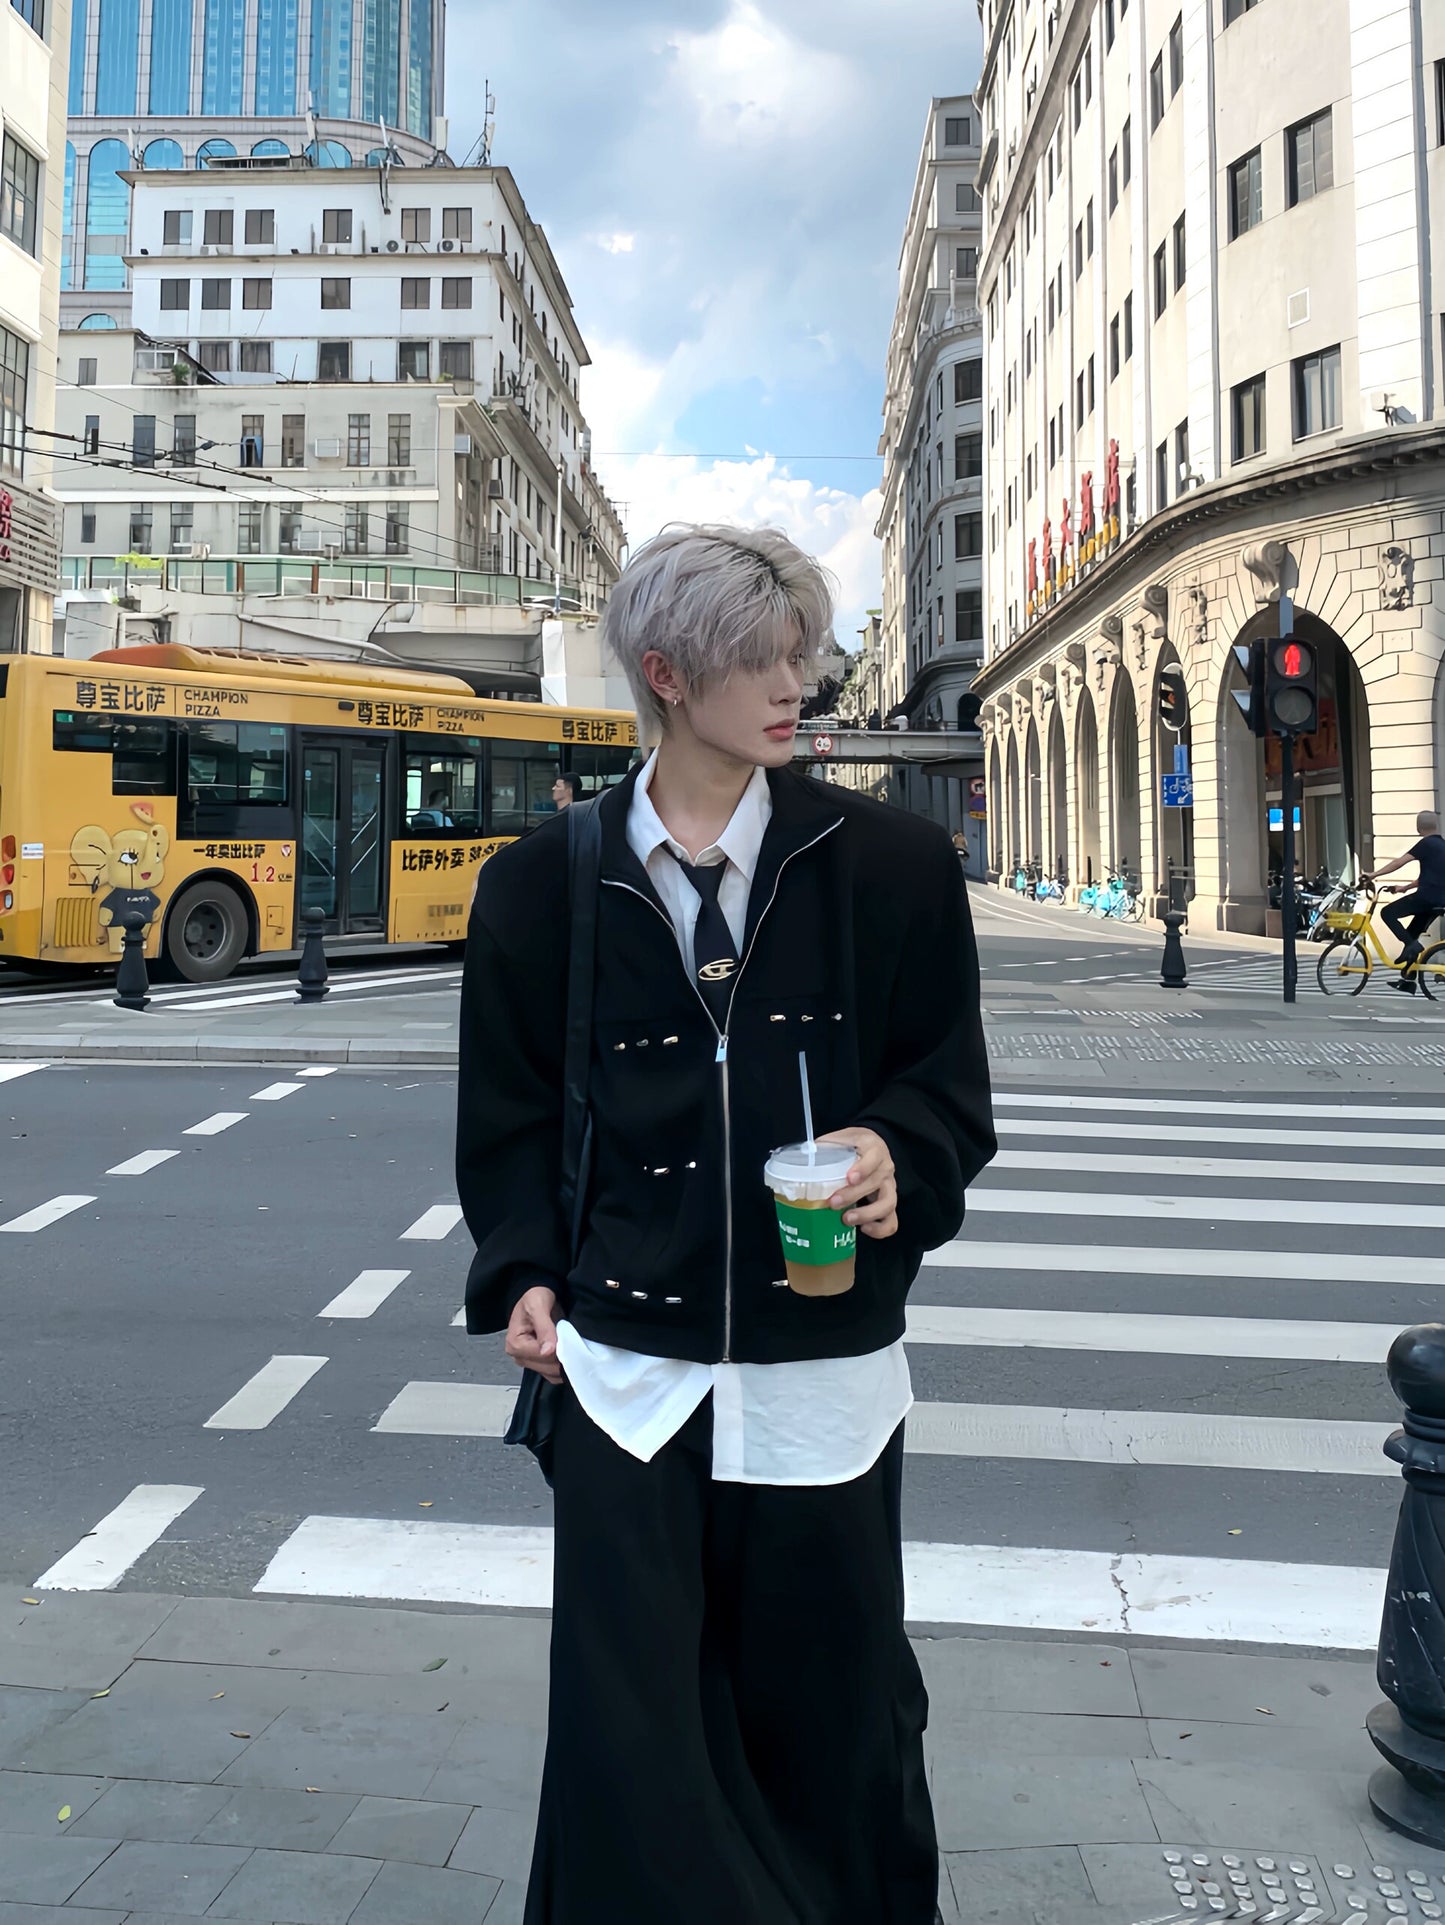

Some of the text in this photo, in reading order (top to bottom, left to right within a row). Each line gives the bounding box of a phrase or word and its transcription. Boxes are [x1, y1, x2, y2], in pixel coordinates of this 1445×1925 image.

[76, 680, 166, 713] 尊宝比萨
[184, 689, 249, 704] CHAMPION
[185, 704, 222, 717] PIZZA
[358, 701, 424, 728] 尊宝比萨
[436, 707, 485, 722] CHAMPION
[437, 720, 464, 733] PIZZA
[193, 843, 266, 859] 一年卖出比萨
[402, 848, 465, 871] 比萨外卖
[250, 862, 275, 883] 1.2
